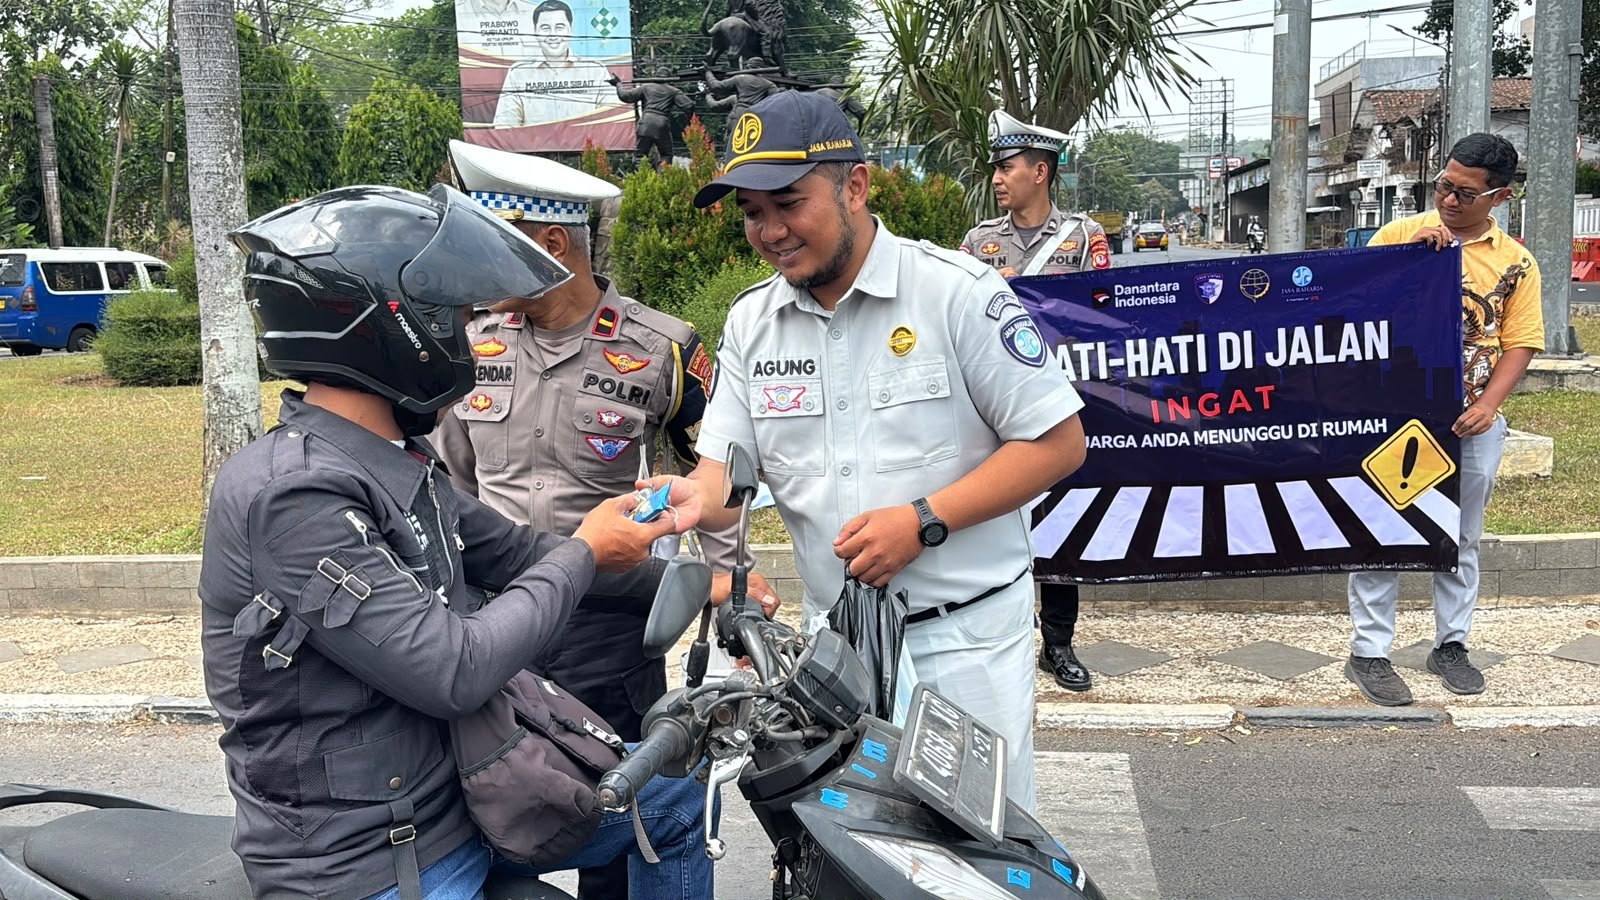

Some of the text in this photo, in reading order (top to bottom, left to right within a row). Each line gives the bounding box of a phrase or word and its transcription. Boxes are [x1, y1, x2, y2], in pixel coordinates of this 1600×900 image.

[480, 20, 518, 28] PRABOWO
[808, 142, 826, 152] JASA
[1114, 282, 1180, 296] Danantara
[1115, 293, 1176, 308] Indonesia
[395, 313, 422, 349] maestro
[1056, 320, 1389, 382] ATI-HATI DI JALAN
[753, 359, 816, 378] AGUNG
[583, 373, 651, 405] POLRI
[1150, 385, 1275, 423] INGAT
[1141, 431, 1191, 448] ANDA
[1194, 424, 1293, 445] MENUNGGU
[1297, 423, 1318, 438] DI
[1322, 418, 1388, 437] RUMAH
[920, 728, 957, 778] 4068
[914, 769, 949, 797] T
